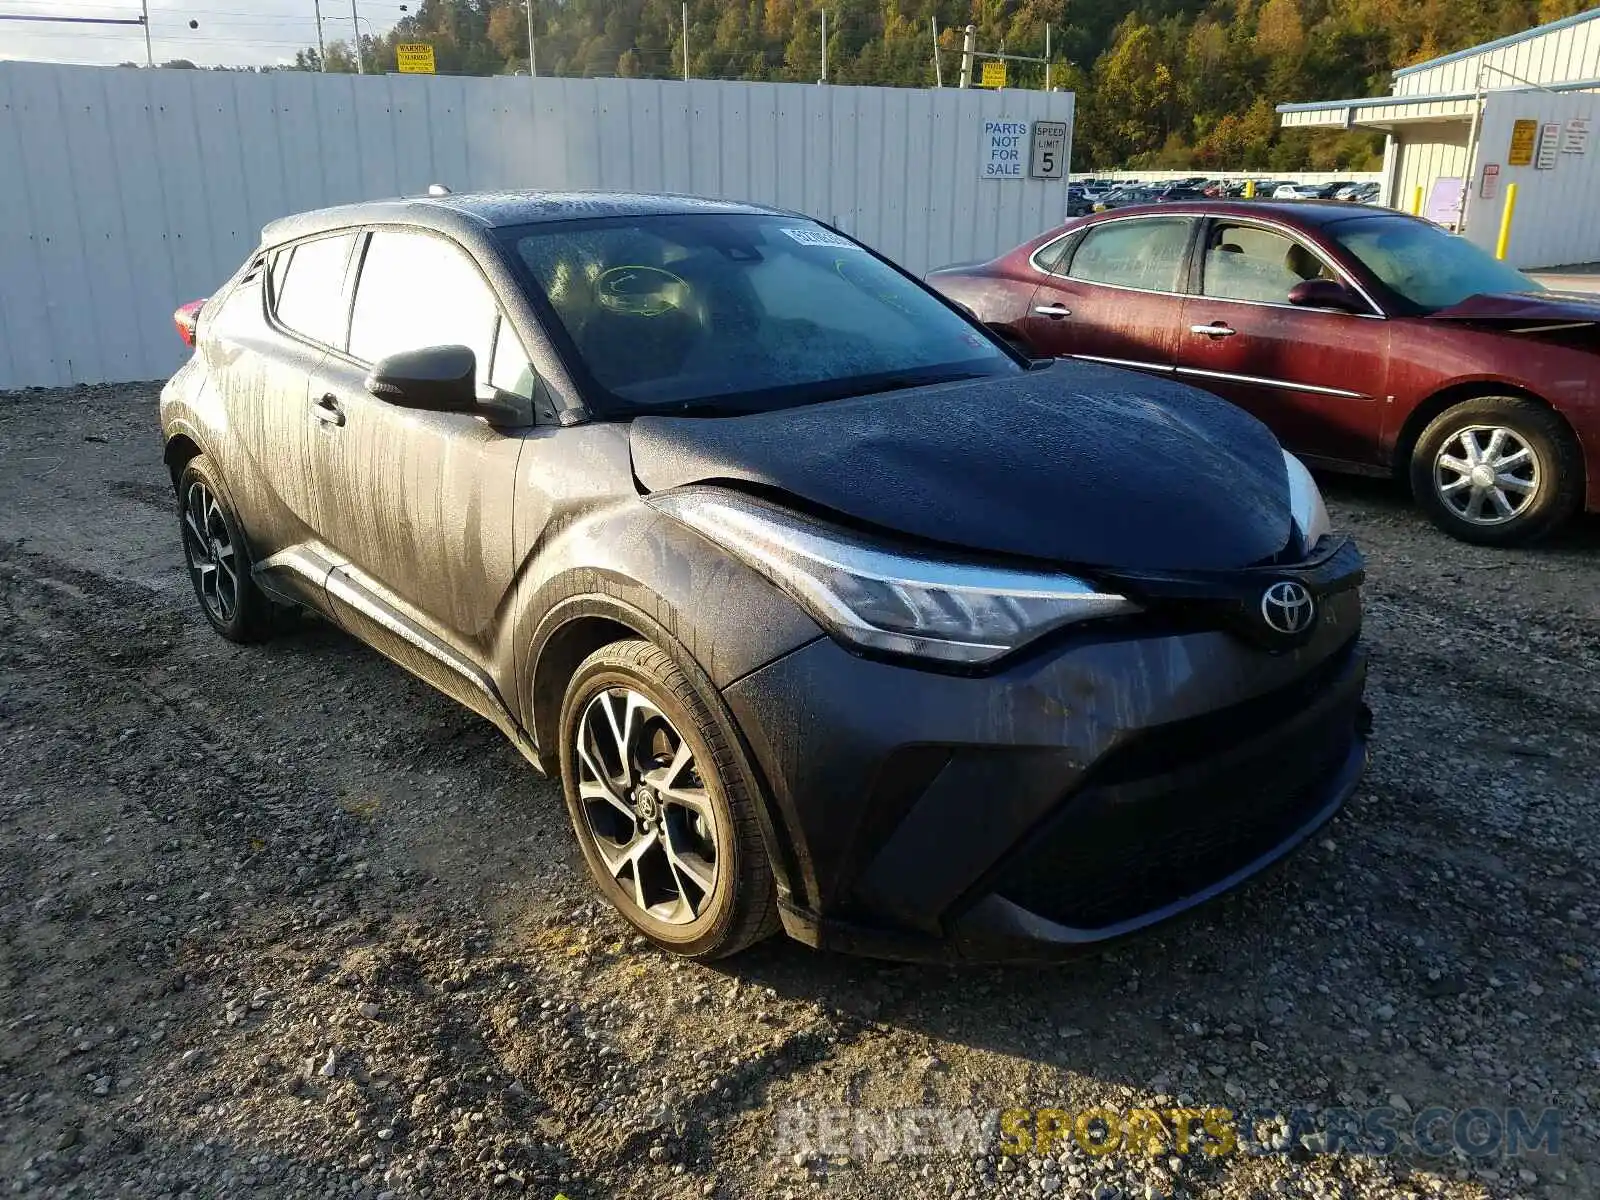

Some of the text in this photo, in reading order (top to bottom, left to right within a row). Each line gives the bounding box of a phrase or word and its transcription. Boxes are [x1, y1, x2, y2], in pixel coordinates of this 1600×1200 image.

[985, 123, 1026, 135] PARTS
[1036, 127, 1064, 137] SPEED
[991, 136, 1020, 147] NOT
[1038, 140, 1059, 149] LIMIT
[991, 149, 1019, 160] FOR
[1042, 152, 1054, 172] 5
[986, 163, 1021, 175] SALE
